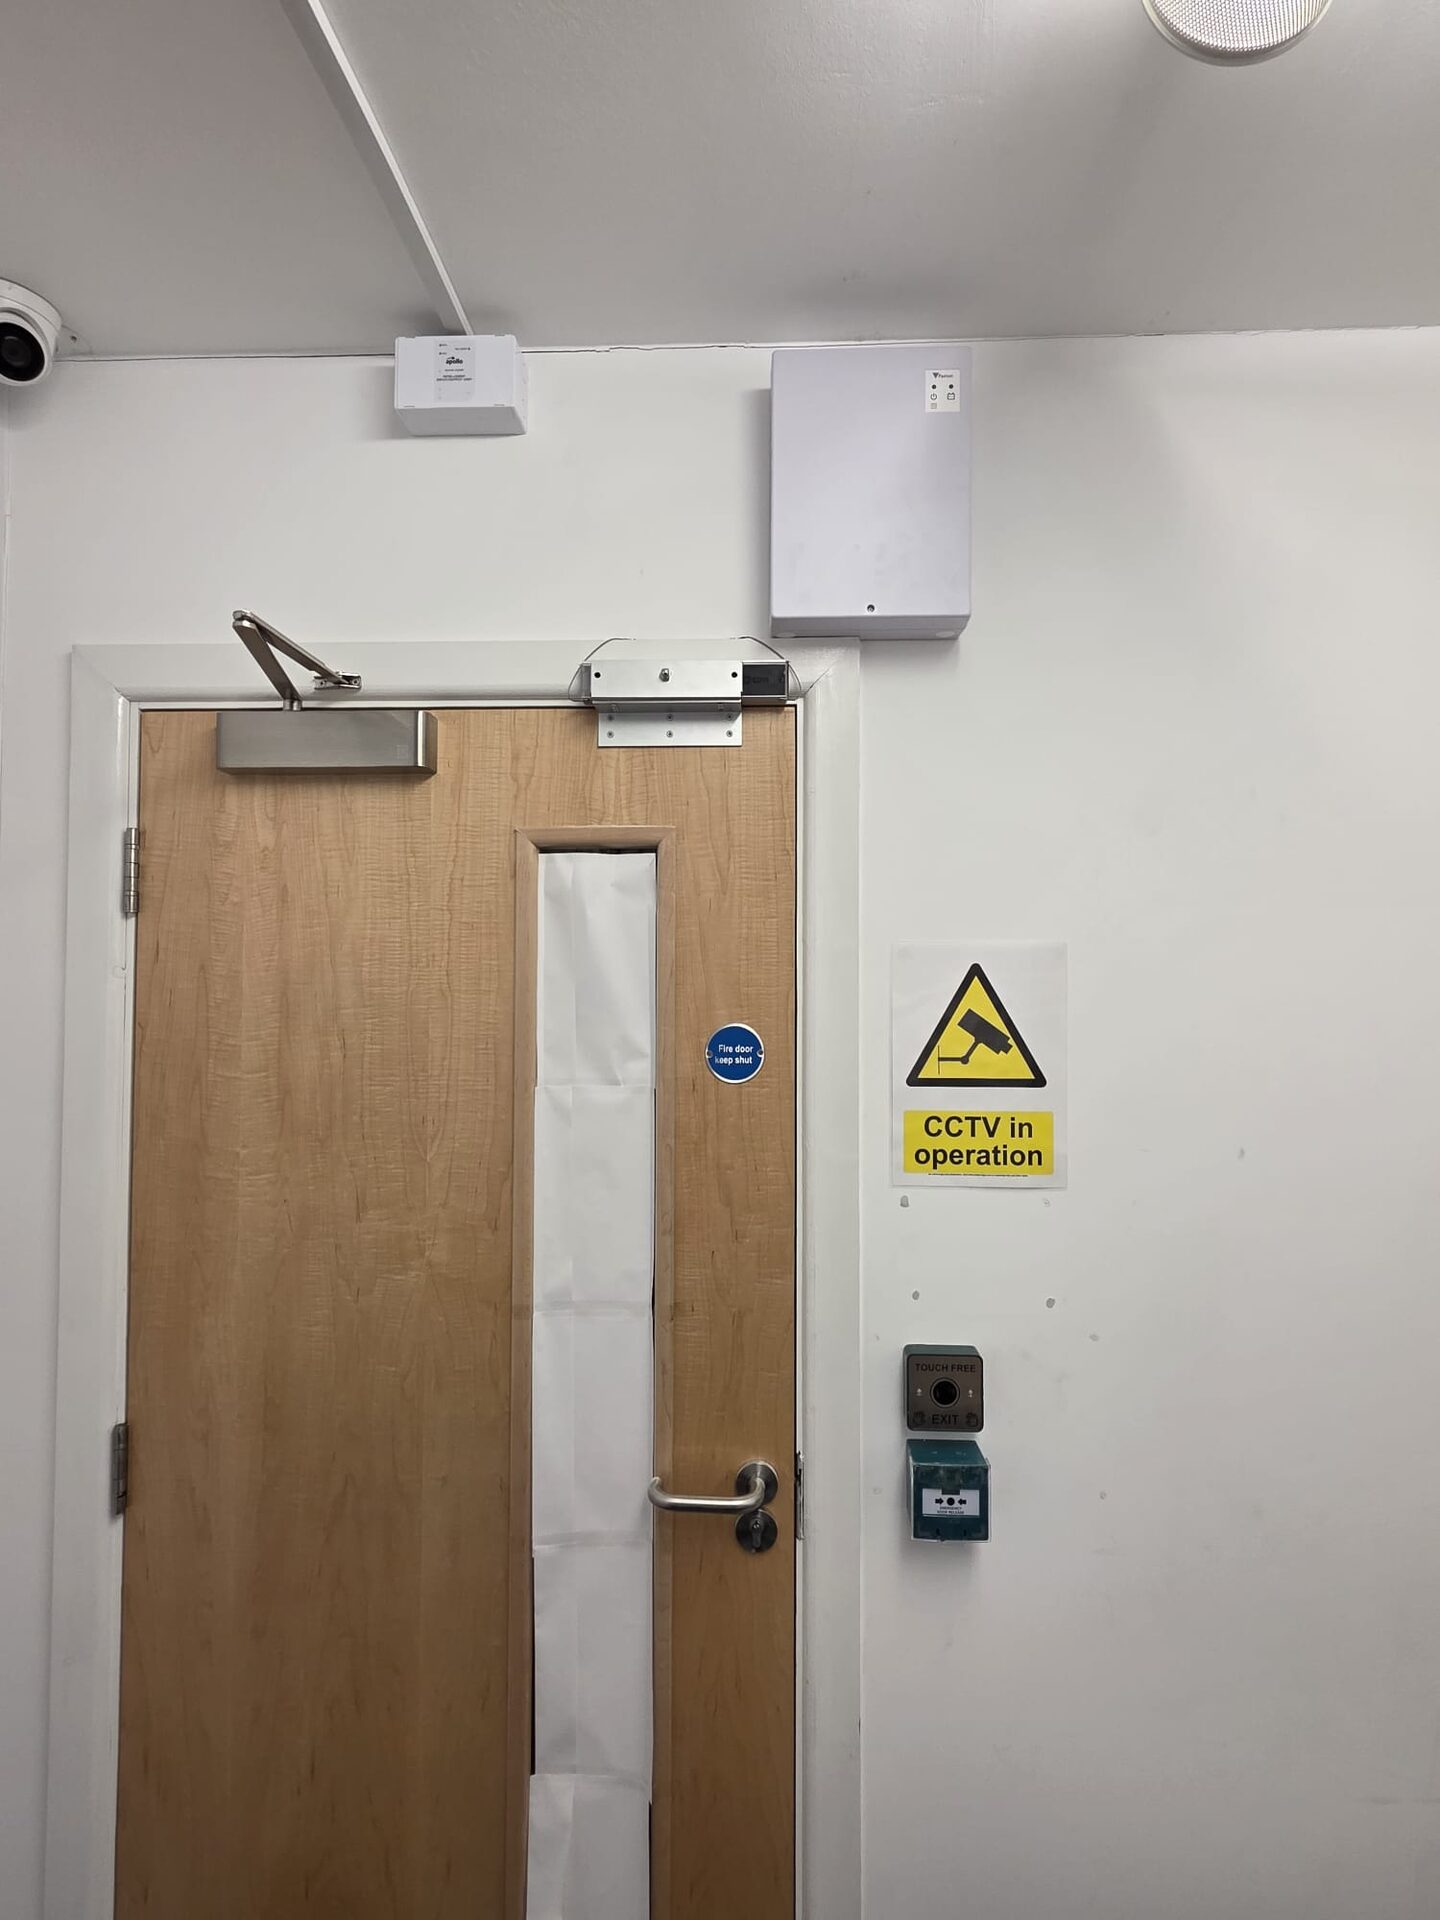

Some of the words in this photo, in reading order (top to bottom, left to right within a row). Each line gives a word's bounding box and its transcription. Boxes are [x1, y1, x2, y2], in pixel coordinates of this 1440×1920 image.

[718, 1044, 733, 1053] Fire
[735, 1044, 753, 1053] door
[715, 1056, 733, 1066] keep
[735, 1055, 753, 1064] shut
[924, 1115, 1001, 1138] CCTV
[1010, 1117, 1033, 1138] in
[914, 1144, 1043, 1170] operation
[915, 1363, 948, 1372] TOUCH
[951, 1364, 976, 1373] FREE
[932, 1414, 959, 1425] EXIT
